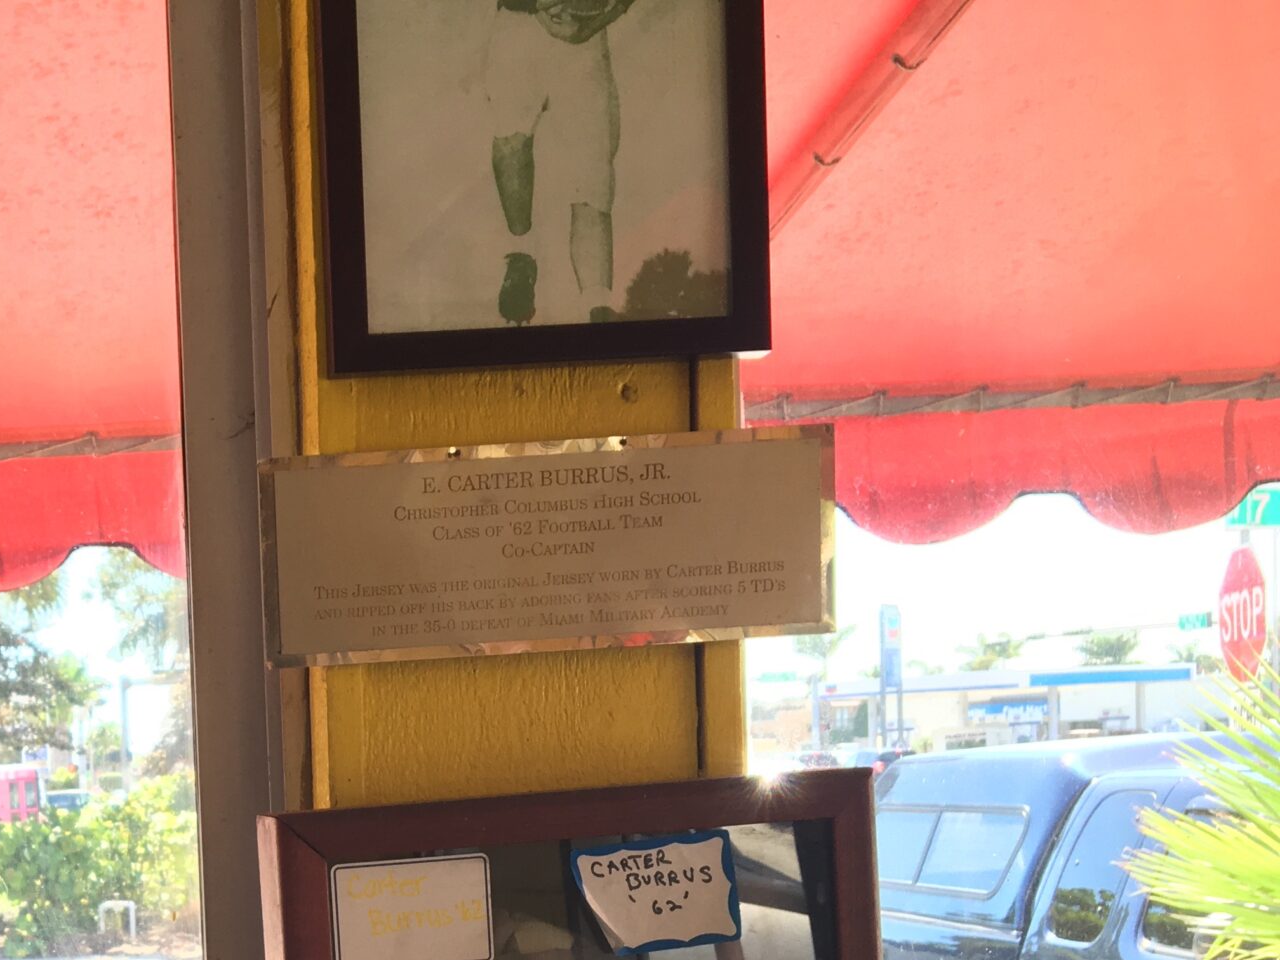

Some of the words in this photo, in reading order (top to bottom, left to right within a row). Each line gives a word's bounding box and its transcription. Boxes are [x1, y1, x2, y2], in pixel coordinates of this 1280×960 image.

[422, 476, 441, 494] E.
[448, 471, 534, 492] CARTER
[540, 464, 634, 487] BURRUS,
[639, 462, 671, 481] JR.
[393, 504, 499, 521] CHRISTOPHER
[504, 498, 588, 515] COLUMBUS
[593, 494, 634, 509] HIGH
[639, 491, 702, 507] SCHOOL
[432, 526, 480, 541] CLASS
[485, 525, 504, 538] OF
[509, 521, 533, 536] '62
[538, 519, 616, 534] FOOTBALL
[620, 514, 664, 530] TEAM
[501, 541, 595, 559] CO-CAPTAIN
[313, 585, 349, 600] THIS
[351, 584, 405, 598] JERSEY
[409, 582, 438, 594] WAS
[441, 580, 469, 593] THE
[473, 575, 538, 591] ORIGINAL
[542, 572, 596, 587] JERSEY
[599, 569, 639, 583] WORN
[644, 567, 663, 580] BY
[666, 564, 723, 578] CARTER
[727, 560, 785, 575] BURRUS
[314, 608, 343, 621] AND
[347, 605, 396, 618] RIPPED
[400, 602, 427, 615] OFF
[431, 601, 454, 613] HIS
[458, 598, 494, 612] BACK
[499, 596, 517, 609] BY
[521, 593, 582, 608] ADORING
[586, 591, 619, 604] FANS
[625, 588, 669, 601] AFTER
[672, 584, 733, 599] SCORING
[737, 580, 746, 594] 5
[750, 577, 787, 593] TD'S
[1222, 585, 1264, 643] STOP
[371, 624, 387, 637] IN
[390, 623, 419, 636] THE
[423, 618, 456, 634] 35-0
[461, 617, 512, 632] DEFEAT
[516, 616, 535, 629] OF
[539, 611, 585, 627] MIAMI
[590, 608, 656, 624] MILITARY
[661, 604, 730, 620] ACADEMY
[590, 849, 672, 878] CARTER
[625, 866, 713, 891] BURRUS
[347, 870, 428, 899] Carter
[367, 907, 454, 937] Burrus
